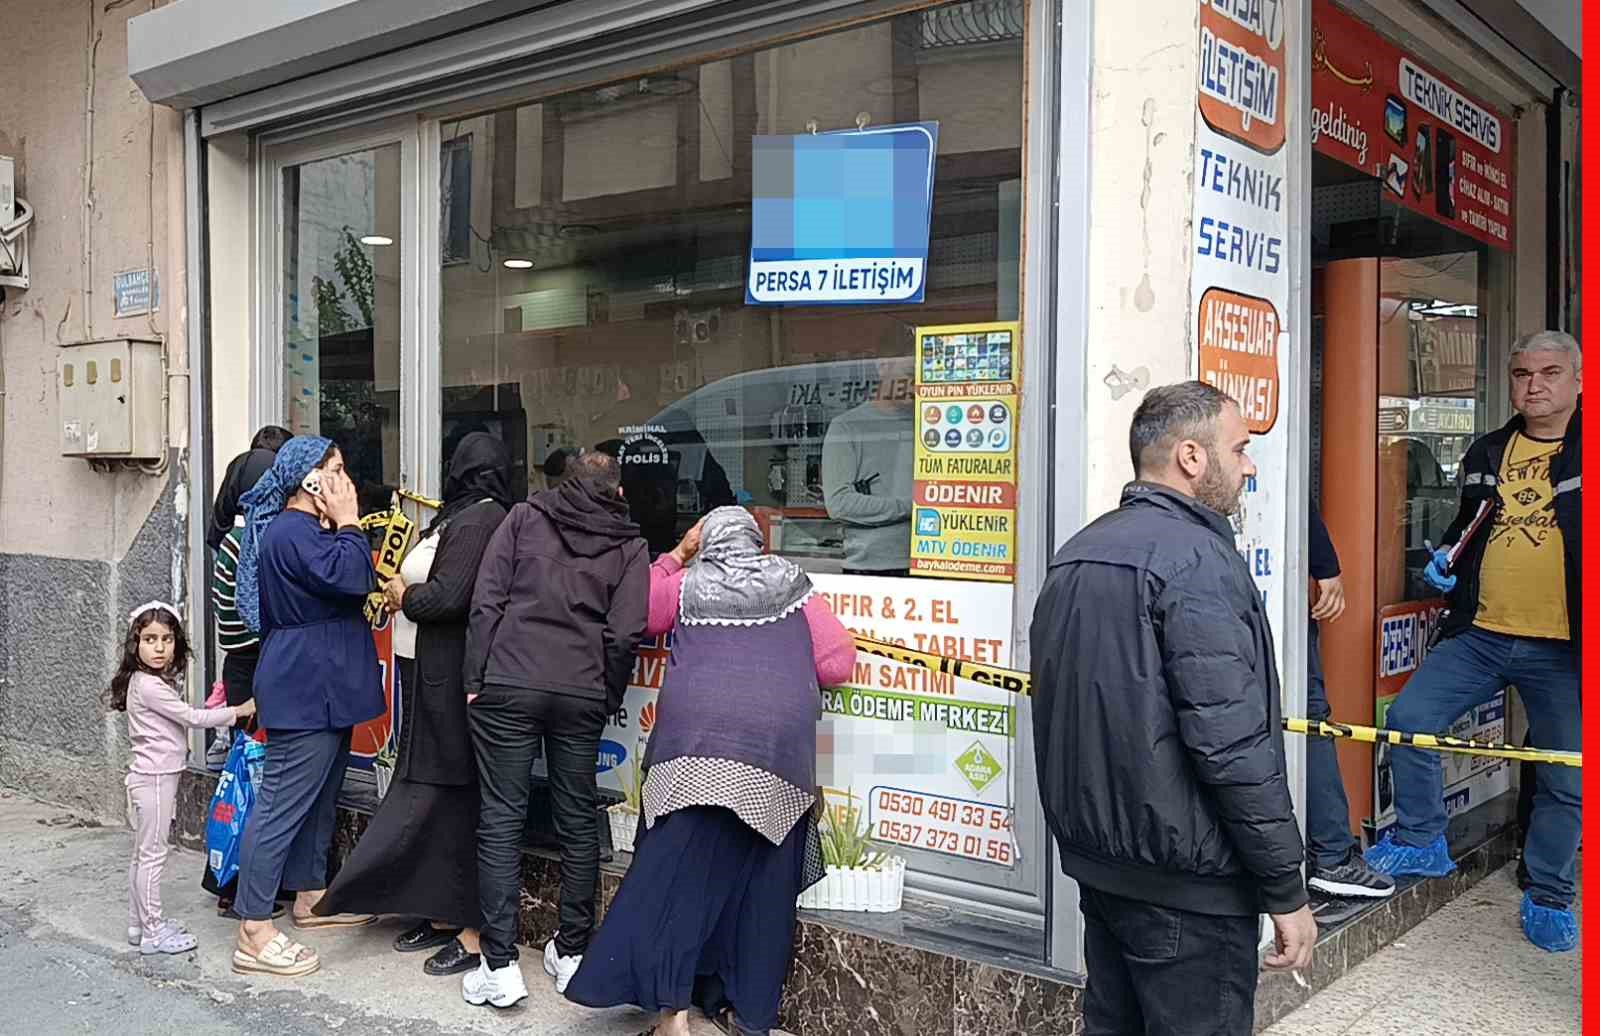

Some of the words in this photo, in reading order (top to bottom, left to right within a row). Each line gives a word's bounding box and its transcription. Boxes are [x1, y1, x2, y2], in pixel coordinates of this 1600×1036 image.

[1201, 32, 1276, 126] İLETİŞİM
[1404, 65, 1453, 122] TEKNİK
[1455, 98, 1497, 149] SERVİS
[1311, 101, 1368, 165] geldiniz
[1201, 148, 1282, 213] TEKNİK
[1197, 216, 1282, 274] SERVİS
[755, 270, 812, 292] PERSA
[818, 269, 828, 290] 7
[833, 260, 914, 296] İLETİŞİM
[1203, 299, 1275, 357] AKSESUAR
[919, 386, 945, 397] OYUN
[625, 452, 661, 464] POLİS
[919, 454, 943, 474] TÜM
[947, 458, 1011, 475] FATURALAR
[942, 509, 1008, 533] YÜKLENİR
[382, 522, 410, 568] POL
[917, 540, 946, 554] MTV
[1255, 548, 1271, 576] EL
[882, 596, 897, 620] &
[904, 598, 923, 622] 2.
[931, 599, 959, 625] EL
[914, 633, 1003, 664] TABLET
[1382, 614, 1416, 675] PERSA
[850, 688, 914, 721] ÖDEME
[921, 701, 1009, 734] MERKEZİ
[879, 790, 924, 816] 0530
[928, 799, 957, 822] 491
[961, 805, 985, 827] 33
[989, 810, 1010, 832] 54
[879, 819, 922, 845] 0537
[926, 828, 960, 853] 373
[964, 836, 982, 857] 01
[986, 842, 1010, 862] 56
